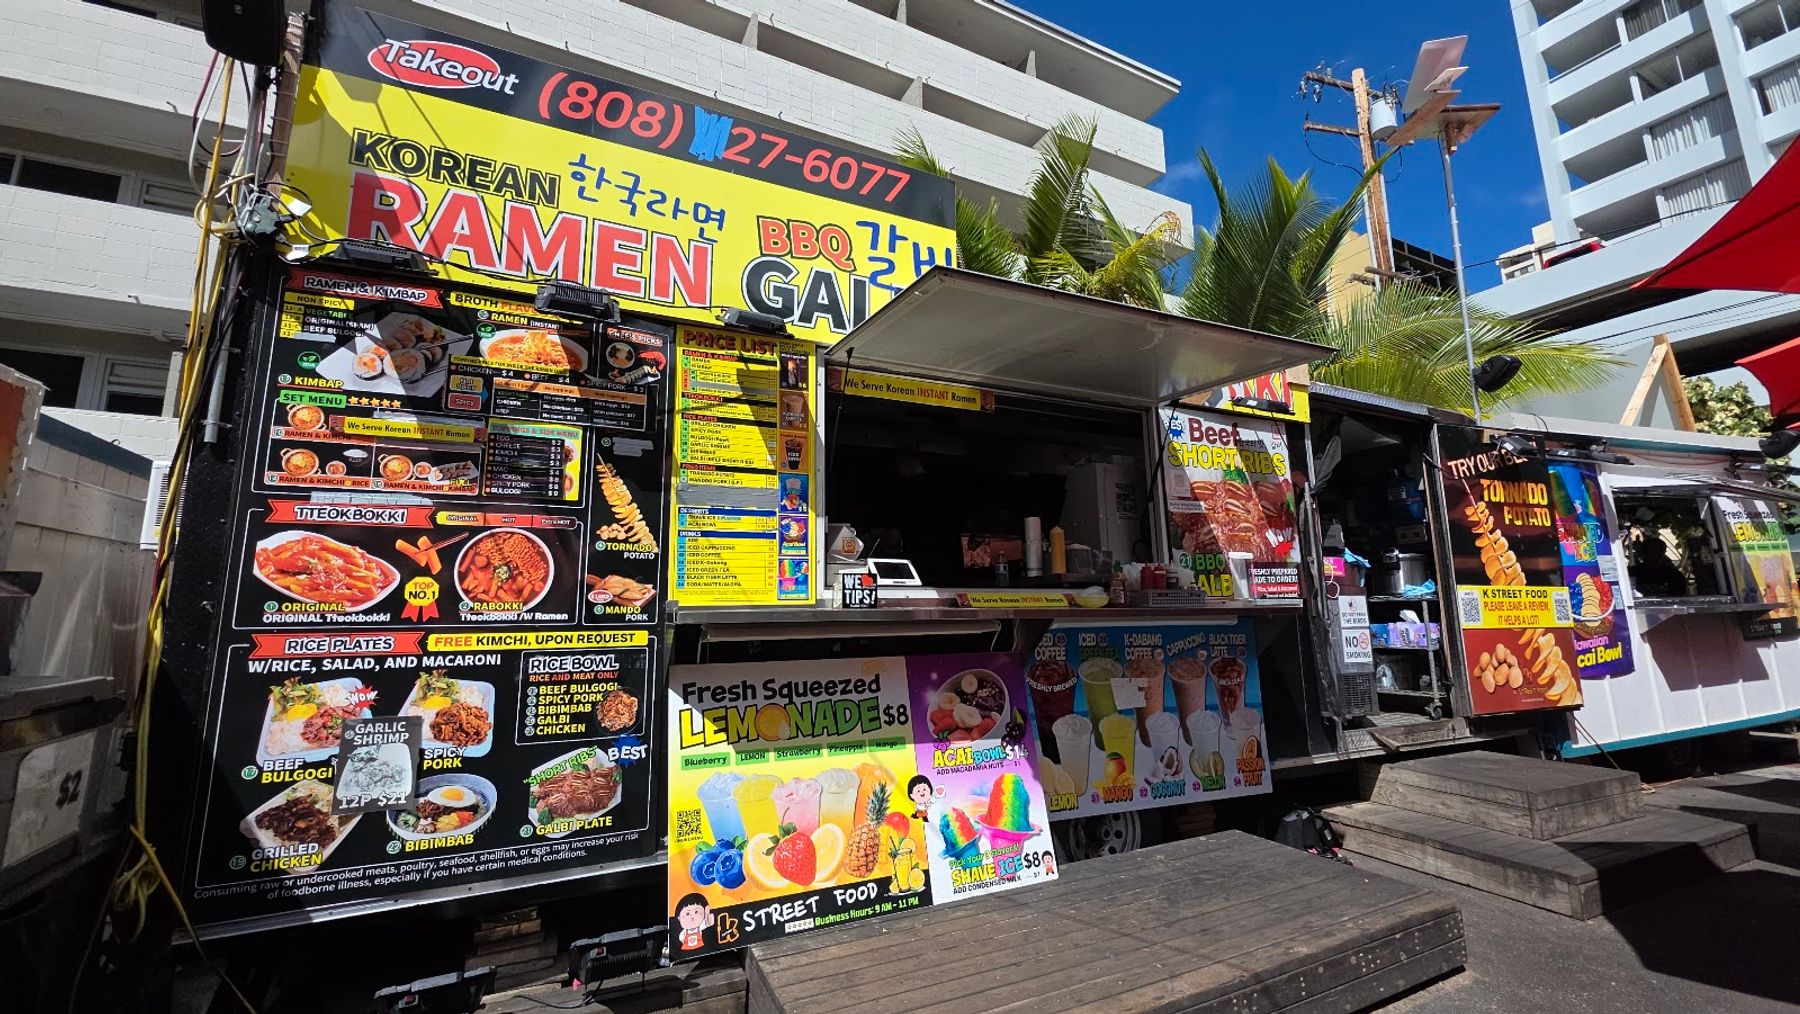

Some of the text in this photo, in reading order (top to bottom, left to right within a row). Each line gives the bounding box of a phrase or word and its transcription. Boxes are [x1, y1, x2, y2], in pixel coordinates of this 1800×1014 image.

[385, 38, 520, 96] Takeout
[538, 71, 911, 202] (808) 27-6077
[350, 127, 561, 209] KOREAN
[346, 170, 857, 309] RAMEN BBQ
[856, 220, 953, 293] 갈비
[304, 276, 428, 302] RAMEN KIMBAP
[319, 297, 343, 307] SPICY
[455, 293, 498, 309] BROTH
[490, 312, 528, 326] RAMEN
[683, 329, 737, 350] PRICE
[740, 336, 777, 356] LIST
[294, 376, 344, 389] KIMBAP
[283, 392, 343, 406] SET MENU
[861, 380, 977, 404] Serve Korean INSTANT Ramen
[362, 422, 444, 437] Serve Korean INSTANT
[1187, 417, 1239, 446] Beef
[1167, 441, 1286, 477] SHORT RIBS
[1447, 457, 1475, 479] TRY
[278, 476, 345, 487] RAMEN KIMCHI
[383, 480, 410, 490] RAMEN
[1480, 478, 1548, 506] TORNADO
[294, 505, 408, 524] TTEOKBOKKI
[1504, 505, 1551, 527] POTATO
[1723, 509, 1744, 519] Fresh
[606, 541, 653, 552] TORNADO
[1573, 542, 1597, 562] ICE
[623, 551, 655, 560] POTATO
[1195, 553, 1225, 571] BBQ
[413, 580, 433, 590] TOP
[844, 574, 862, 588] WE
[844, 589, 875, 606] TIPS!
[1482, 588, 1490, 599] K
[1491, 588, 1523, 599] STREET
[1526, 589, 1548, 598] FOOD
[281, 602, 346, 613] ORIGINAL
[473, 601, 524, 612] RABOKKI
[605, 605, 641, 615] MANDO
[1483, 601, 1523, 612] PLEASE LEAVE
[262, 613, 323, 624] ORIGINAL
[534, 611, 569, 621] Ramen
[625, 613, 649, 621] PORK
[1504, 615, 1521, 625] HELPS
[285, 636, 395, 654] RICE PLATES
[434, 632, 636, 648] FREE KIMCHI, UPON REQUEST
[1078, 632, 1097, 647] ICED
[1124, 633, 1162, 646] K-DABANG
[1166, 632, 1206, 657] CAPPUCCINO
[1345, 636, 1359, 649] NO
[1034, 646, 1066, 661] COFFEE
[1125, 647, 1153, 660] COFFEE
[1346, 651, 1371, 659] SMOKING
[1577, 641, 1622, 668] cai Bowl
[248, 653, 501, 674] W/RICE, SALAD, AND MACARONI
[528, 654, 619, 673] RICE BOWL
[529, 671, 619, 682] RICE AND MEAT ONLY
[539, 682, 618, 695] BEEF BULGOGI
[682, 674, 881, 704] Fresh Squeezed
[1026, 677, 1077, 693] FRESHLY BREWED
[538, 693, 604, 705] SPICY PORK
[538, 703, 592, 715] BIBIMBAB
[355, 721, 407, 734] GARLIC
[537, 715, 570, 725] GALBI
[679, 696, 909, 749] LEMONADE $8
[536, 723, 586, 735] CHICKEN
[353, 732, 410, 746] SHRIMP
[423, 746, 466, 760] SPICY
[607, 744, 648, 762] BEST
[684, 739, 898, 767] Blueberry LEMON Strawberry Pineapple Mango
[933, 745, 1006, 769] ACAI BOWL
[263, 757, 304, 772] BEEF
[423, 757, 463, 770] PORK
[937, 762, 1004, 776] ADD MACADAMIA NUTS
[1236, 758, 1266, 775] PASSION
[261, 767, 333, 784] BULGOGI
[378, 791, 407, 807] $21
[1049, 776, 1226, 812] LEMON MANGO COCONUT MELON
[536, 816, 613, 836] GALBI PLATE
[251, 842, 319, 860] GRILLED
[405, 834, 474, 852] BIBIMBAB
[194, 836, 624, 900] Consuming raw undercooked poultry, seafood, shellfish, may increase your
[250, 853, 323, 873] CHICKEN
[951, 851, 1040, 887] SHAVE ICE $8
[281, 848, 588, 898] foodborne especially have certain medical conditions.
[953, 879, 1006, 895] ADD CONDENSED
[743, 883, 878, 932] STREET FOOD
[814, 897, 920, 927] Business Hours: PM
